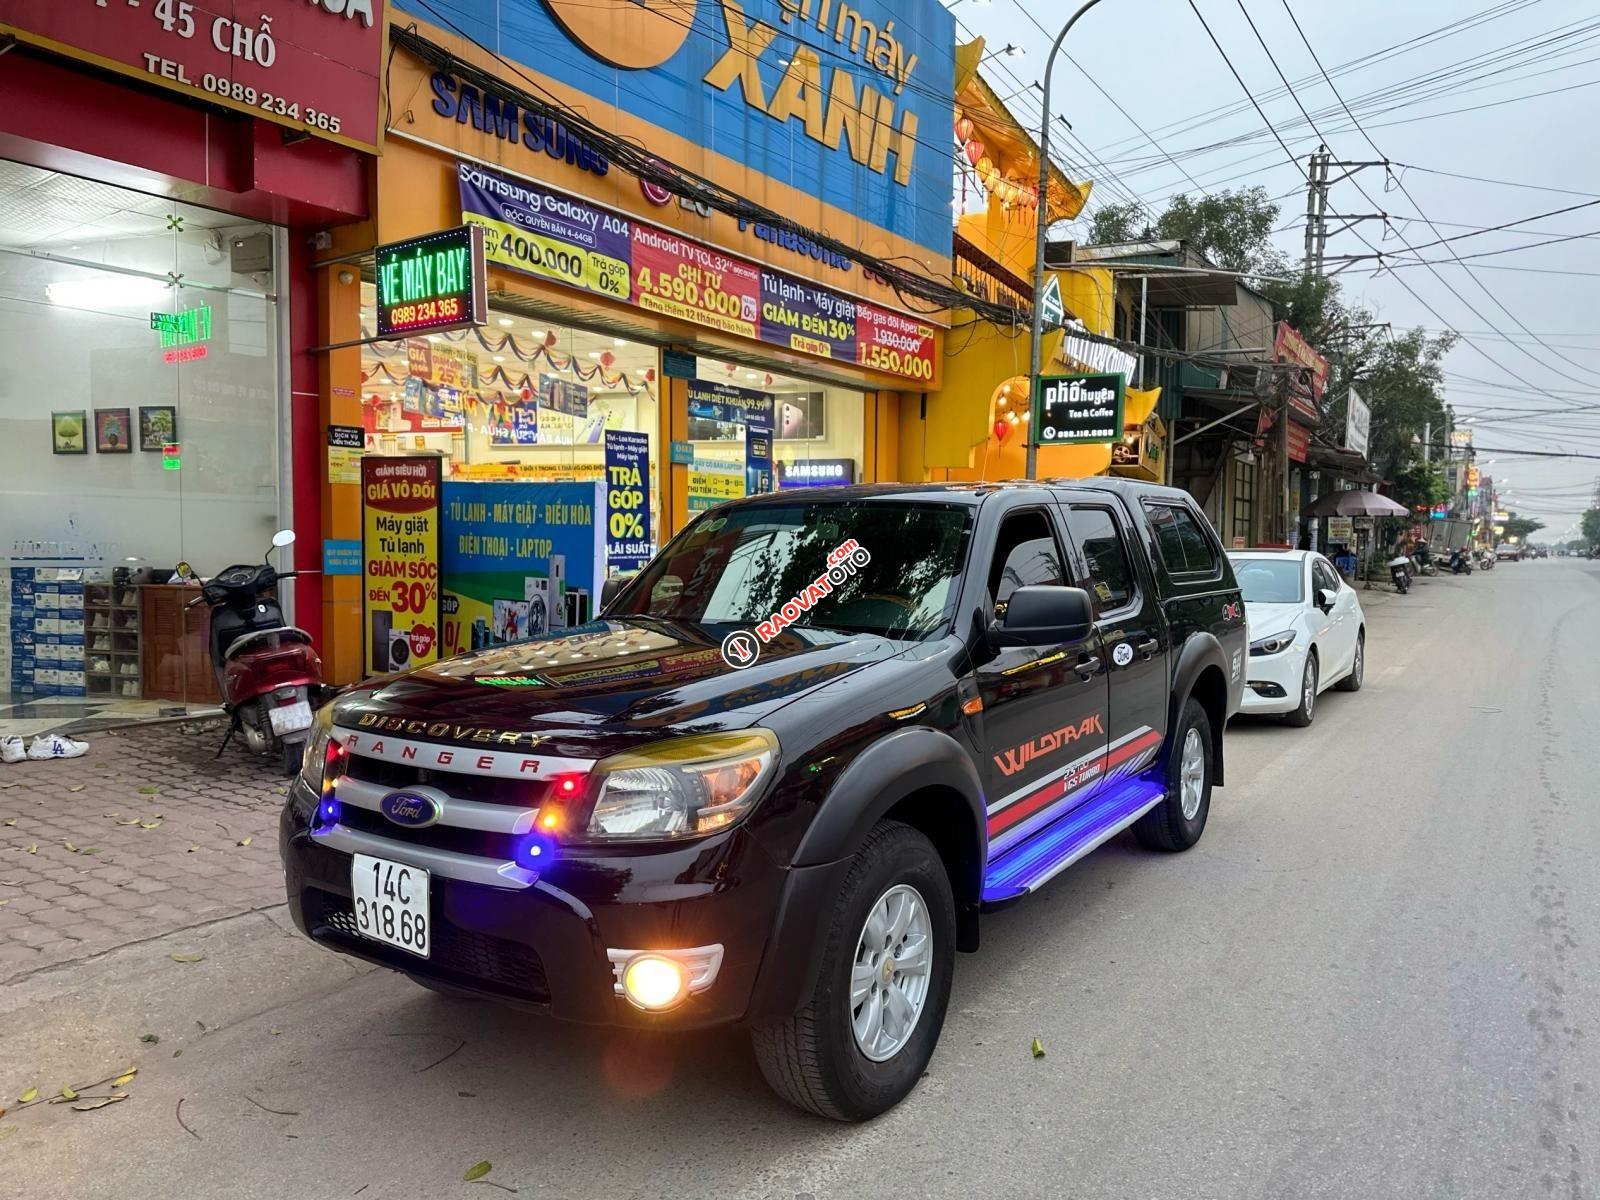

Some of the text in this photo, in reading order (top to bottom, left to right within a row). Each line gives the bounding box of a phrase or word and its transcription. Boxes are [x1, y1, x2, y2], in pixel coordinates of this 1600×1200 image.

[212, 14, 276, 68] CHỖ
[835, 3, 918, 95] máy
[203, 73, 258, 106] 0989
[261, 93, 300, 121] 234
[305, 108, 341, 134] 365
[703, 0, 919, 187] XANH
[459, 163, 630, 238] Samsung Galaxy A04
[504, 207, 524, 223] ĐỘC
[525, 214, 550, 232] QUYỀN
[567, 228, 593, 244] 4-64GB
[500, 233, 582, 278] 400.000
[634, 227, 679, 256] Android
[680, 242, 694, 260] TV
[695, 249, 714, 267] TCL
[381, 247, 466, 306] VÉ MÁY BAY
[592, 256, 625, 277] Trả góp
[704, 271, 723, 290] TỪ
[599, 271, 619, 294] 0%
[637, 266, 741, 318] 4.590.000
[762, 273, 777, 293] Tủ
[779, 278, 805, 303] lạnh
[835, 299, 855, 321] giặt
[391, 298, 458, 325] 0989 234 365
[685, 308, 695, 320] 12
[696, 310, 721, 330] tháng
[744, 305, 755, 319] 0%
[762, 300, 855, 341] GIẢM ĐẾN 30%
[857, 304, 872, 322] Bếp
[873, 312, 887, 325] gas
[900, 319, 918, 335] Apex
[859, 342, 933, 380] 1.550.000
[1046, 378, 1115, 410] phố huyện
[1089, 407, 1114, 417] Coffee
[375, 464, 395, 477] GIẢM
[396, 464, 413, 476] SIÊU
[609, 462, 643, 487] TRẢ
[785, 465, 843, 477] SAMSUNG
[367, 479, 436, 500] GIÁ VÔ ĐỐI
[609, 486, 644, 509] GÓP
[376, 515, 429, 536] Máy giặt
[450, 496, 461, 522] TỦ
[463, 503, 486, 526] LẠNH
[493, 500, 514, 524] MÁY
[516, 503, 538, 528] GIẶT
[545, 501, 569, 525] ĐIỀU
[570, 500, 592, 526] HÒA
[610, 512, 644, 538] 0%
[379, 536, 424, 557] Tủ lạnh
[459, 533, 480, 558] ĐIỆN
[481, 537, 508, 560] THOẠI
[516, 539, 553, 560] LAPTOP
[609, 540, 649, 554] LÃI SUẤT
[368, 555, 406, 578] GIẢM
[408, 556, 437, 580] SỐC
[369, 581, 437, 615] ĐẾN 30%
[358, 713, 552, 747] DISCOVERY
[993, 713, 1105, 777] WILDTRAK
[52, 740, 65, 755] LA
[347, 735, 541, 773] RANGER
[391, 796, 422, 820] Ford
[372, 861, 411, 905] 14C
[356, 896, 427, 951] 318.68
